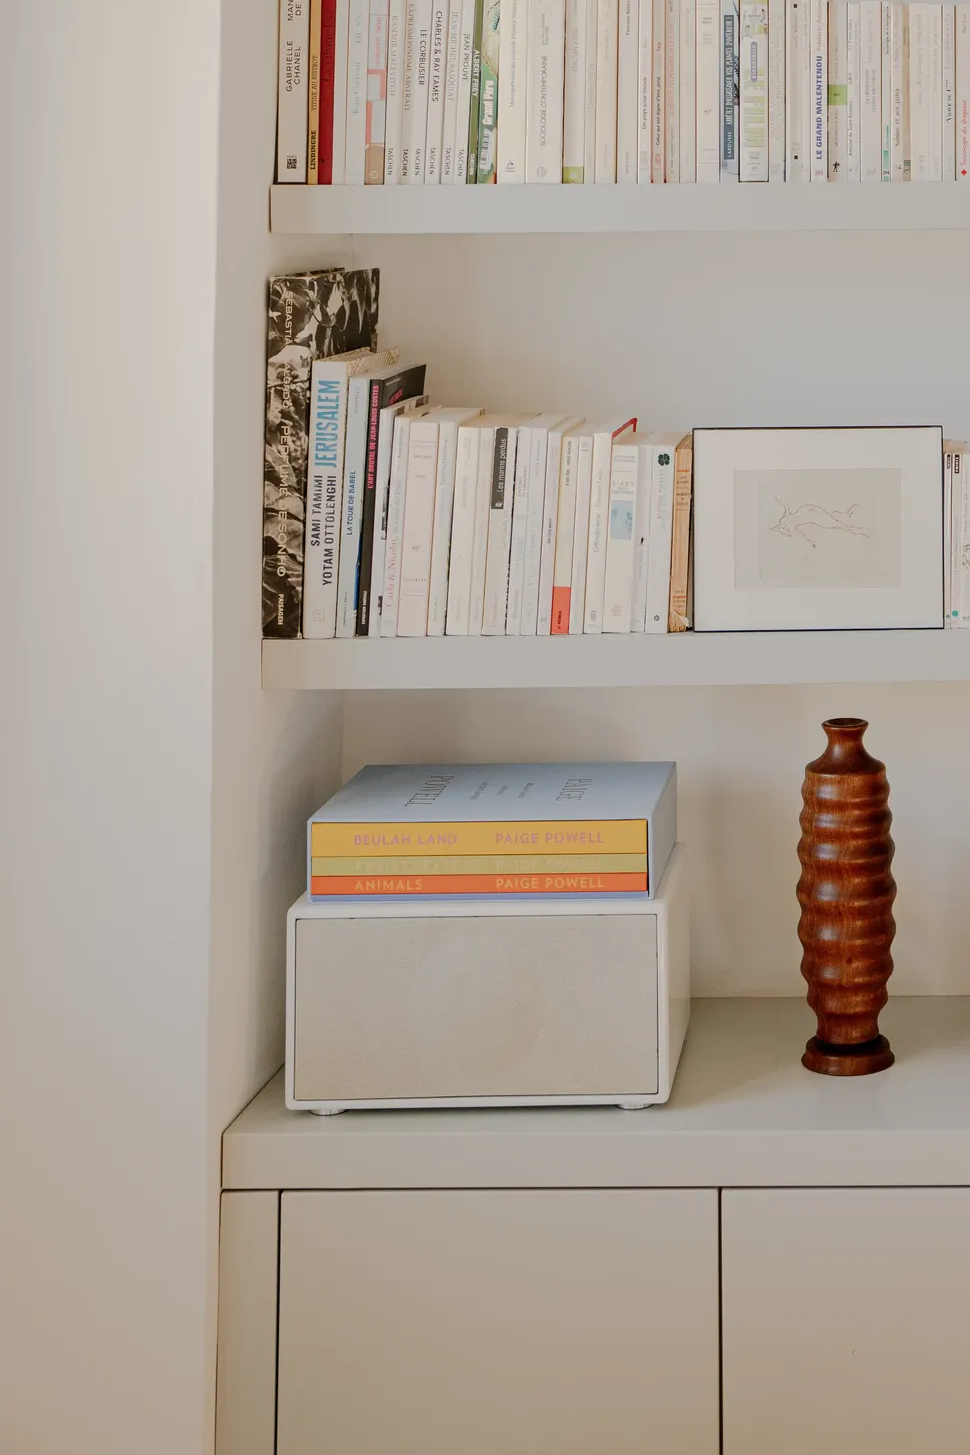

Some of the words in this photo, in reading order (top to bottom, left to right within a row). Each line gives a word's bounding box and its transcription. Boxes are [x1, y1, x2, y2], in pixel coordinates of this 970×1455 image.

[295, 3, 302, 16] DE
[419, 29, 427, 38] LE
[433, 11, 443, 46] CHARLES
[449, 11, 458, 62] JEAN-MICHEL
[463, 33, 471, 50] JEAN
[285, 40, 294, 92] GABRIELLE
[417, 40, 427, 86] CORBUSIER
[432, 58, 441, 73] RAY
[472, 49, 480, 77] ALBERT
[431, 76, 440, 102] EAMES
[447, 64, 456, 102] BASQUIAT
[483, 80, 494, 100] Père
[482, 102, 493, 125] Grand
[540, 109, 548, 146] SOCIOLOGIE
[961, 126, 967, 134] du
[444, 147, 452, 175] TASCHEN
[816, 149, 823, 159] LE
[960, 135, 968, 167] Sociologie
[371, 385, 379, 408] COSTES
[314, 380, 340, 469] JERUSALEM
[369, 409, 378, 442] JEAN-LOUIS
[368, 443, 376, 452] DE
[498, 439, 507, 460] perdus
[367, 452, 376, 473] BRUTAL
[497, 461, 505, 480] marins
[348, 470, 356, 494] BABEL
[367, 474, 375, 489] L'ART
[311, 475, 324, 515] TAMIMI
[348, 496, 355, 505] DE
[324, 475, 337, 544] OTTOLENGHI
[347, 507, 355, 526] TOUR
[310, 518, 322, 547] SAMI
[346, 527, 354, 536] LA
[322, 547, 334, 586] YOTAM
[387, 572, 395, 581] &
[386, 583, 395, 608] Carla
[354, 834, 411, 846] BEULAH
[417, 832, 457, 845] LAND
[495, 832, 538, 844] PAIGE
[544, 832, 605, 844] POWELL
[354, 879, 423, 890] ANIMALS
[495, 877, 539, 889] PAIGE
[545, 877, 605, 889] POWELL
